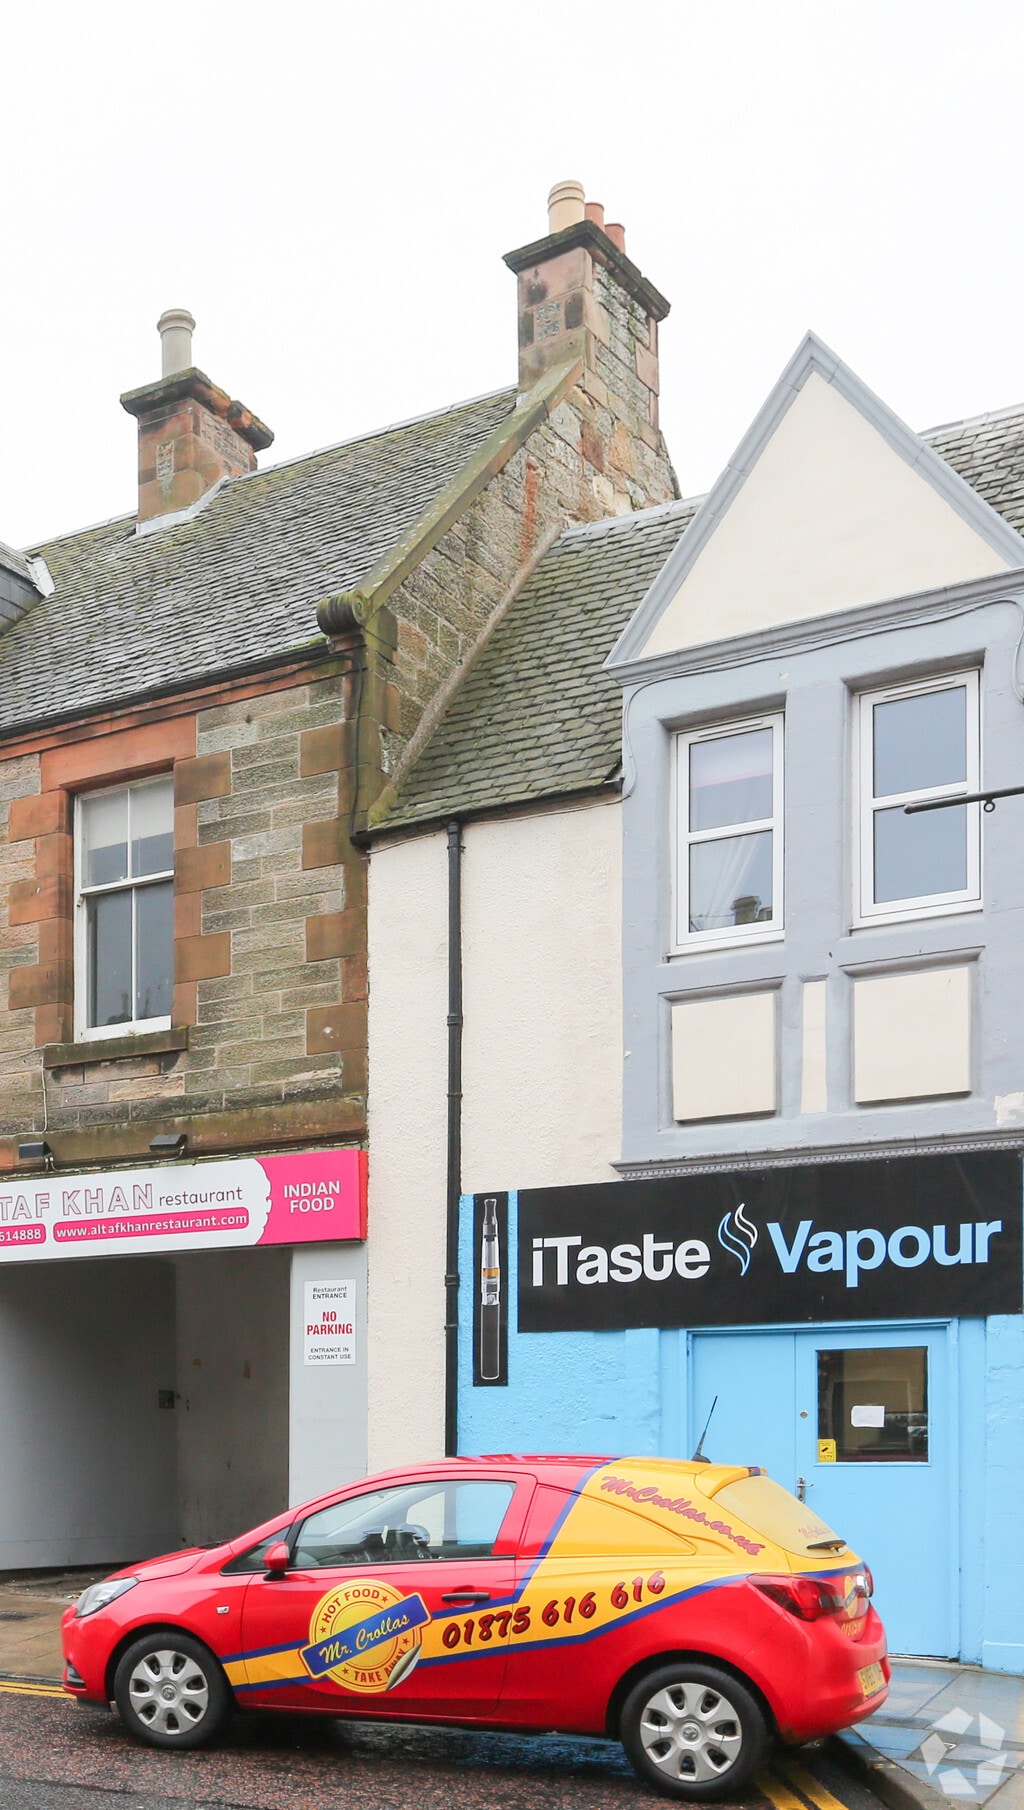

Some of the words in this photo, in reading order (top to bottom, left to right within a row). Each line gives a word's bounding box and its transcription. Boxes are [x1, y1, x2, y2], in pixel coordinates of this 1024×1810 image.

[62, 1183, 154, 1217] KHAN
[159, 1186, 243, 1207] restaurant
[283, 1180, 341, 1199] INDIAN
[289, 1197, 335, 1214] FOOD
[56, 1214, 247, 1239] www.altafkhanrestaurant.com
[532, 1233, 712, 1288] iTaste
[767, 1219, 1003, 1289] Vapour
[306, 1323, 353, 1336] PARKING
[322, 1311, 337, 1322] NO
[322, 1597, 342, 1623] HOT
[344, 1588, 380, 1601] FOOD
[441, 1605, 531, 1649] 01875
[542, 1591, 597, 1627] 616
[610, 1570, 666, 1610] 616
[319, 1641, 353, 1664] Mr.
[355, 1614, 410, 1650] Crollas
[353, 1670, 383, 1683] TAKE
